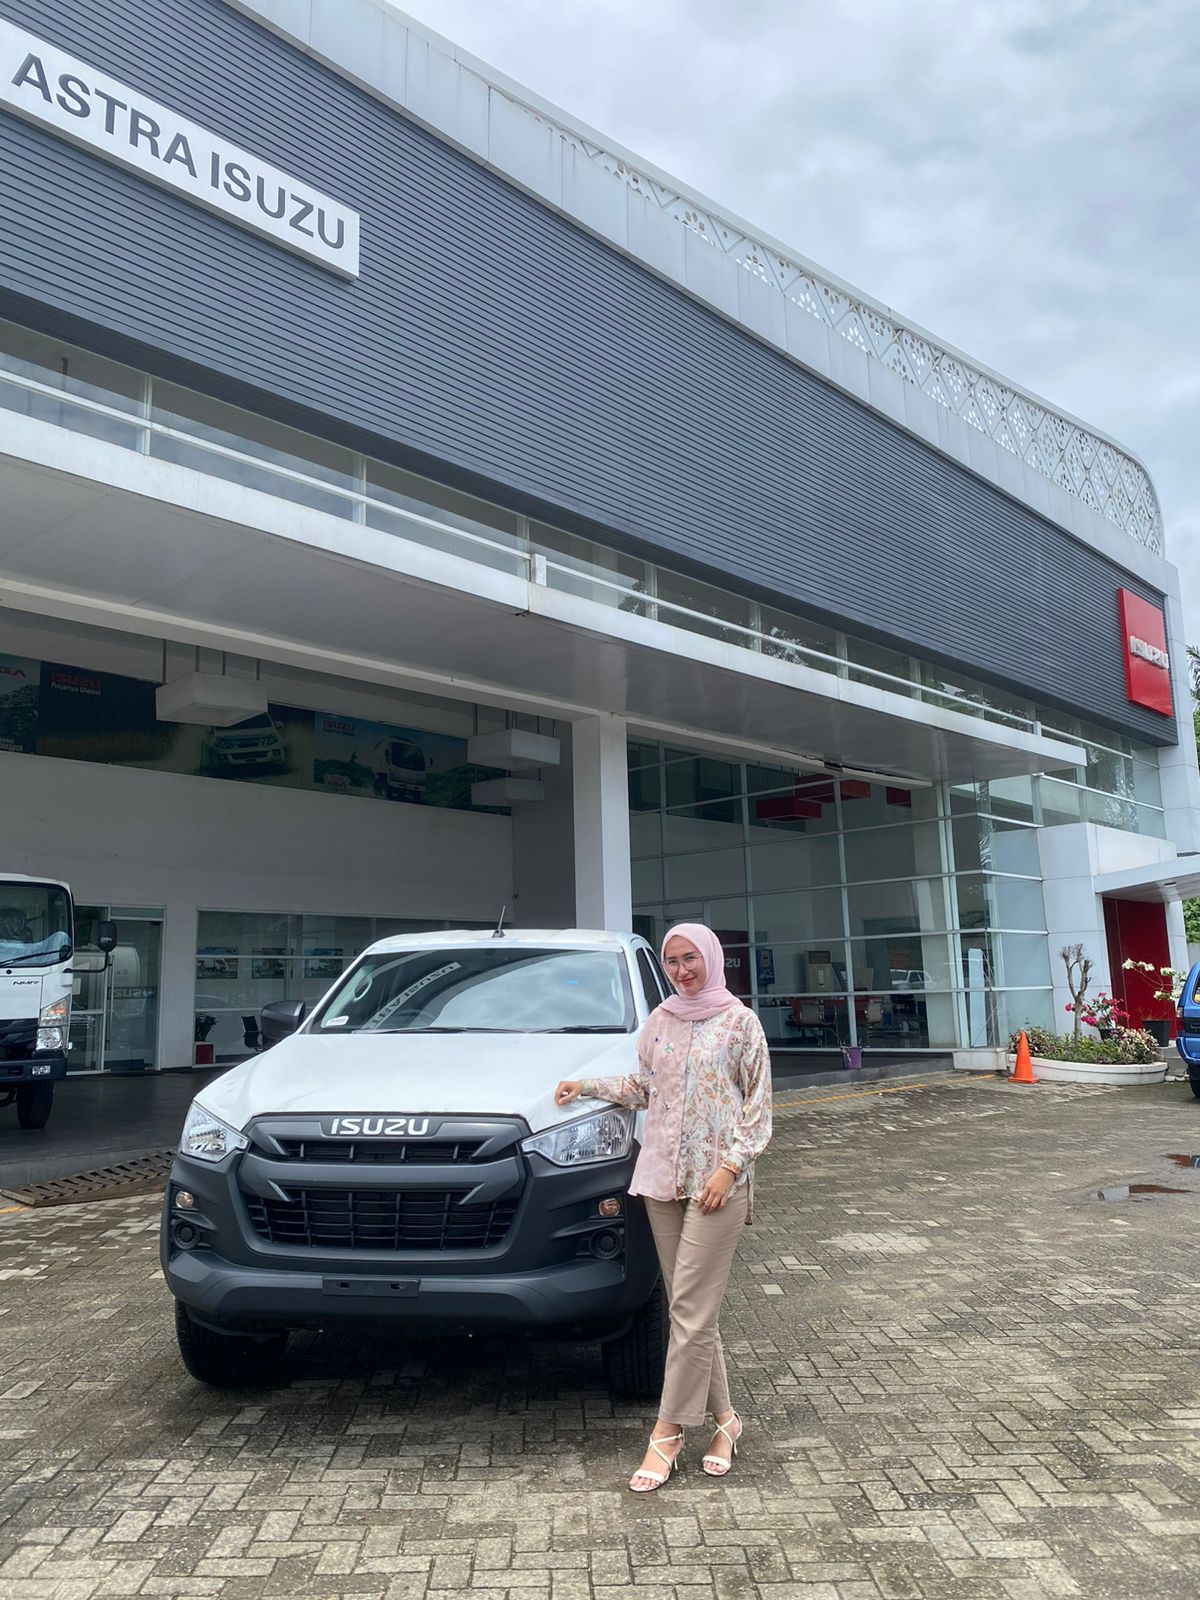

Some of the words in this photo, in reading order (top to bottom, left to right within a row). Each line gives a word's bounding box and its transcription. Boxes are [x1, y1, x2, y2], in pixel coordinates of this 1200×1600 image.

[10, 52, 198, 179] ASTRA
[210, 150, 345, 250] ISUZU
[1129, 635, 1169, 669] ISUZU
[51, 672, 101, 689] ISUZU
[323, 719, 355, 732] ISUZU
[726, 957, 741, 968] ZU
[330, 1118, 429, 1136] ISUZU
